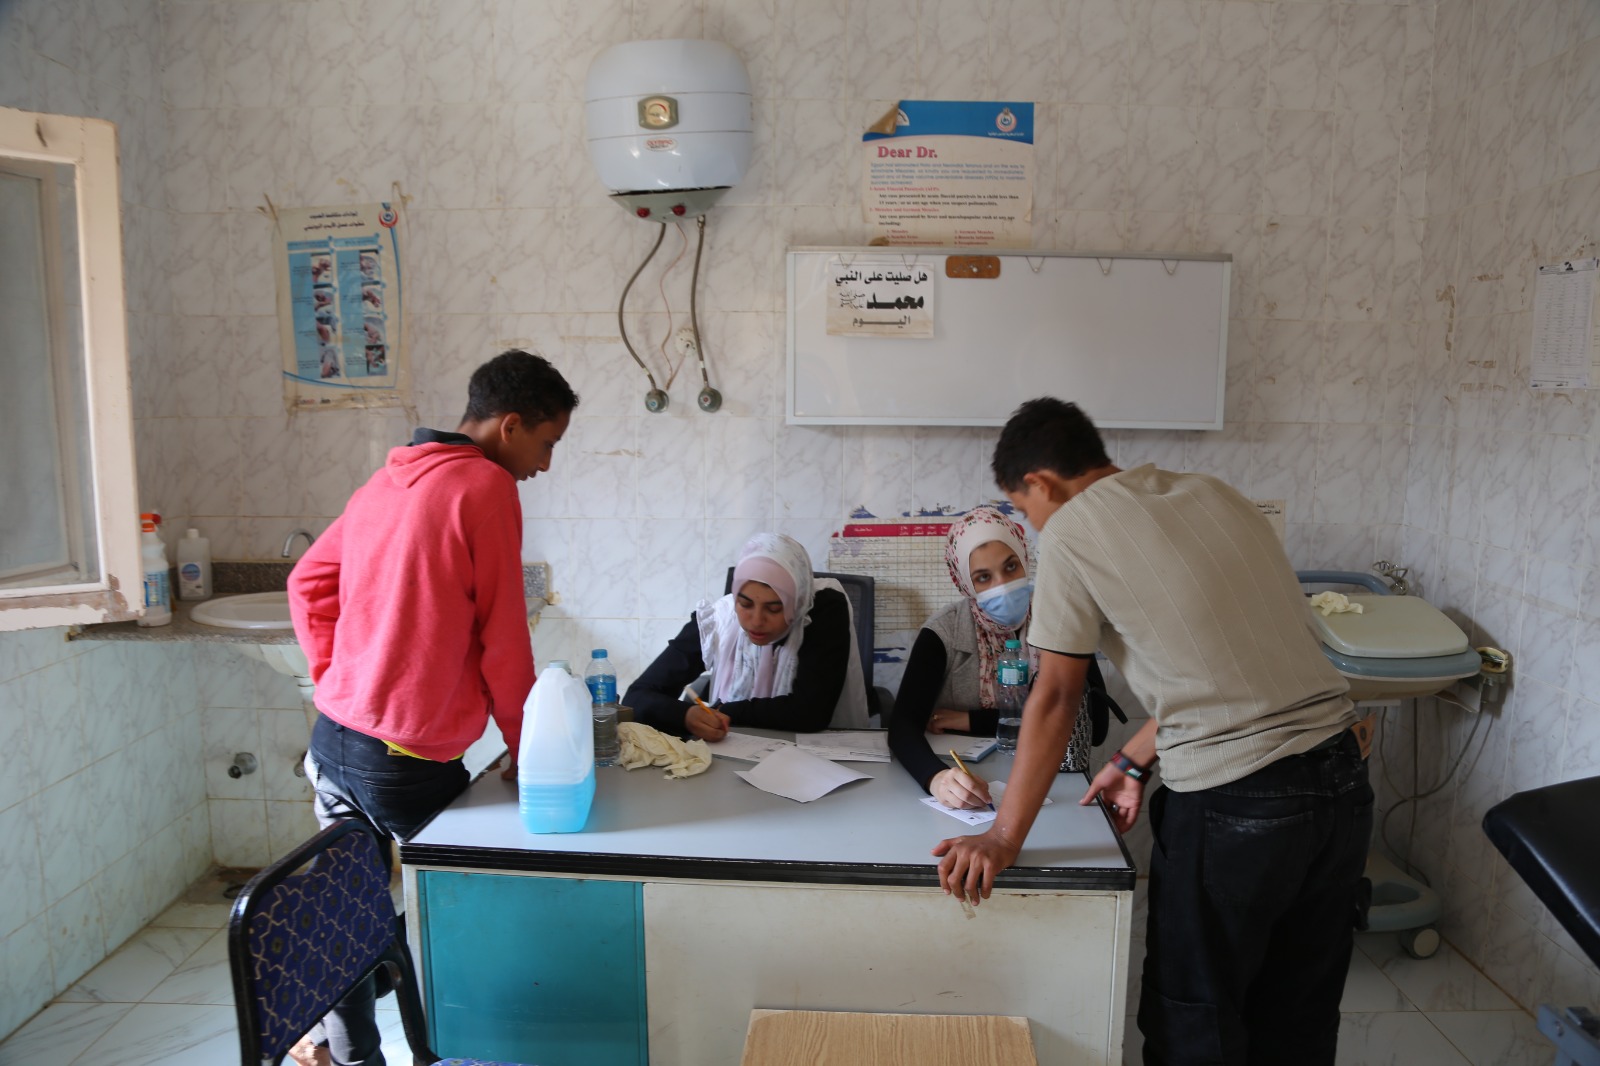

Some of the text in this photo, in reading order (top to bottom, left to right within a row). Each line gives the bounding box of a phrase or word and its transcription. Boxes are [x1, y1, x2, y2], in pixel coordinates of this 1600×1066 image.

[878, 146, 938, 158] Dear Dr.
[835, 270, 928, 286] هل صليت على النبي
[867, 292, 924, 310] محمد
[853, 315, 911, 328] اليوم
